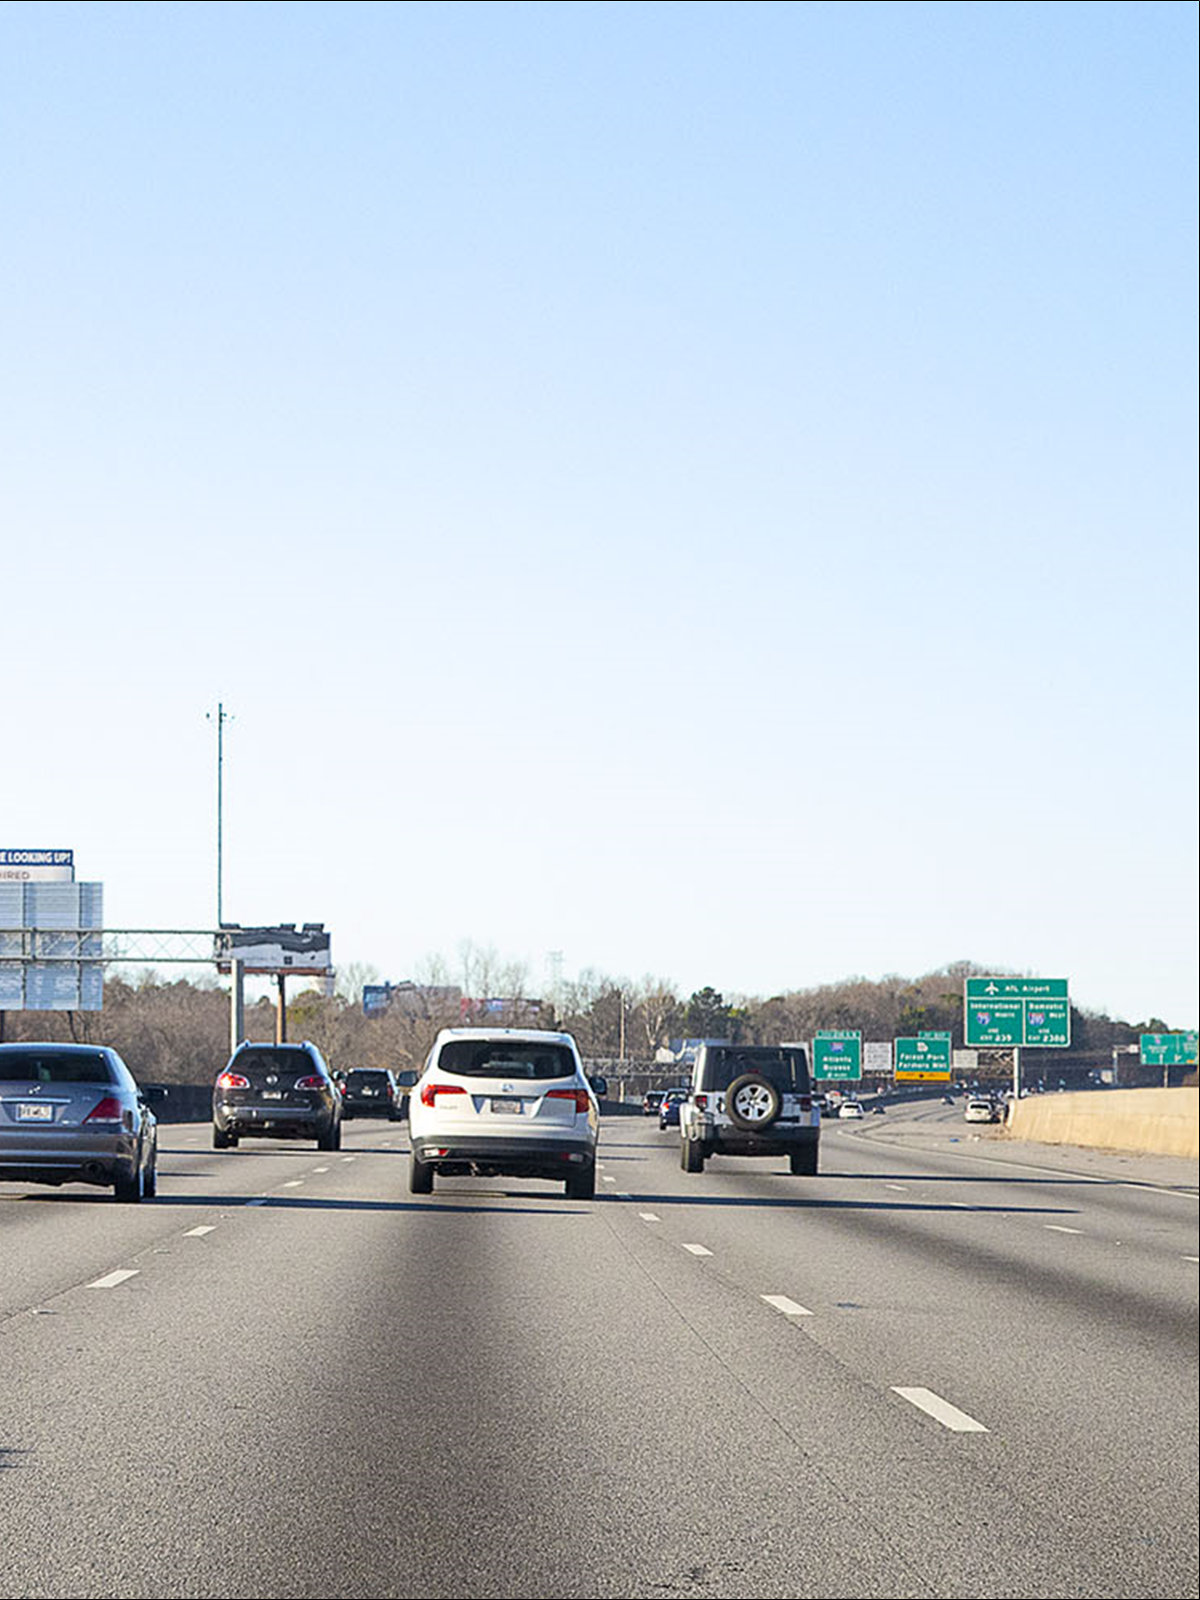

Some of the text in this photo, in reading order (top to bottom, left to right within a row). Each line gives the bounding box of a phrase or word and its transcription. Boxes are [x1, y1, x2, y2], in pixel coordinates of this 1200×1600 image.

[8, 852, 52, 863] LOOKING
[54, 853, 71, 863] UP!
[1022, 985, 1050, 994] Airport
